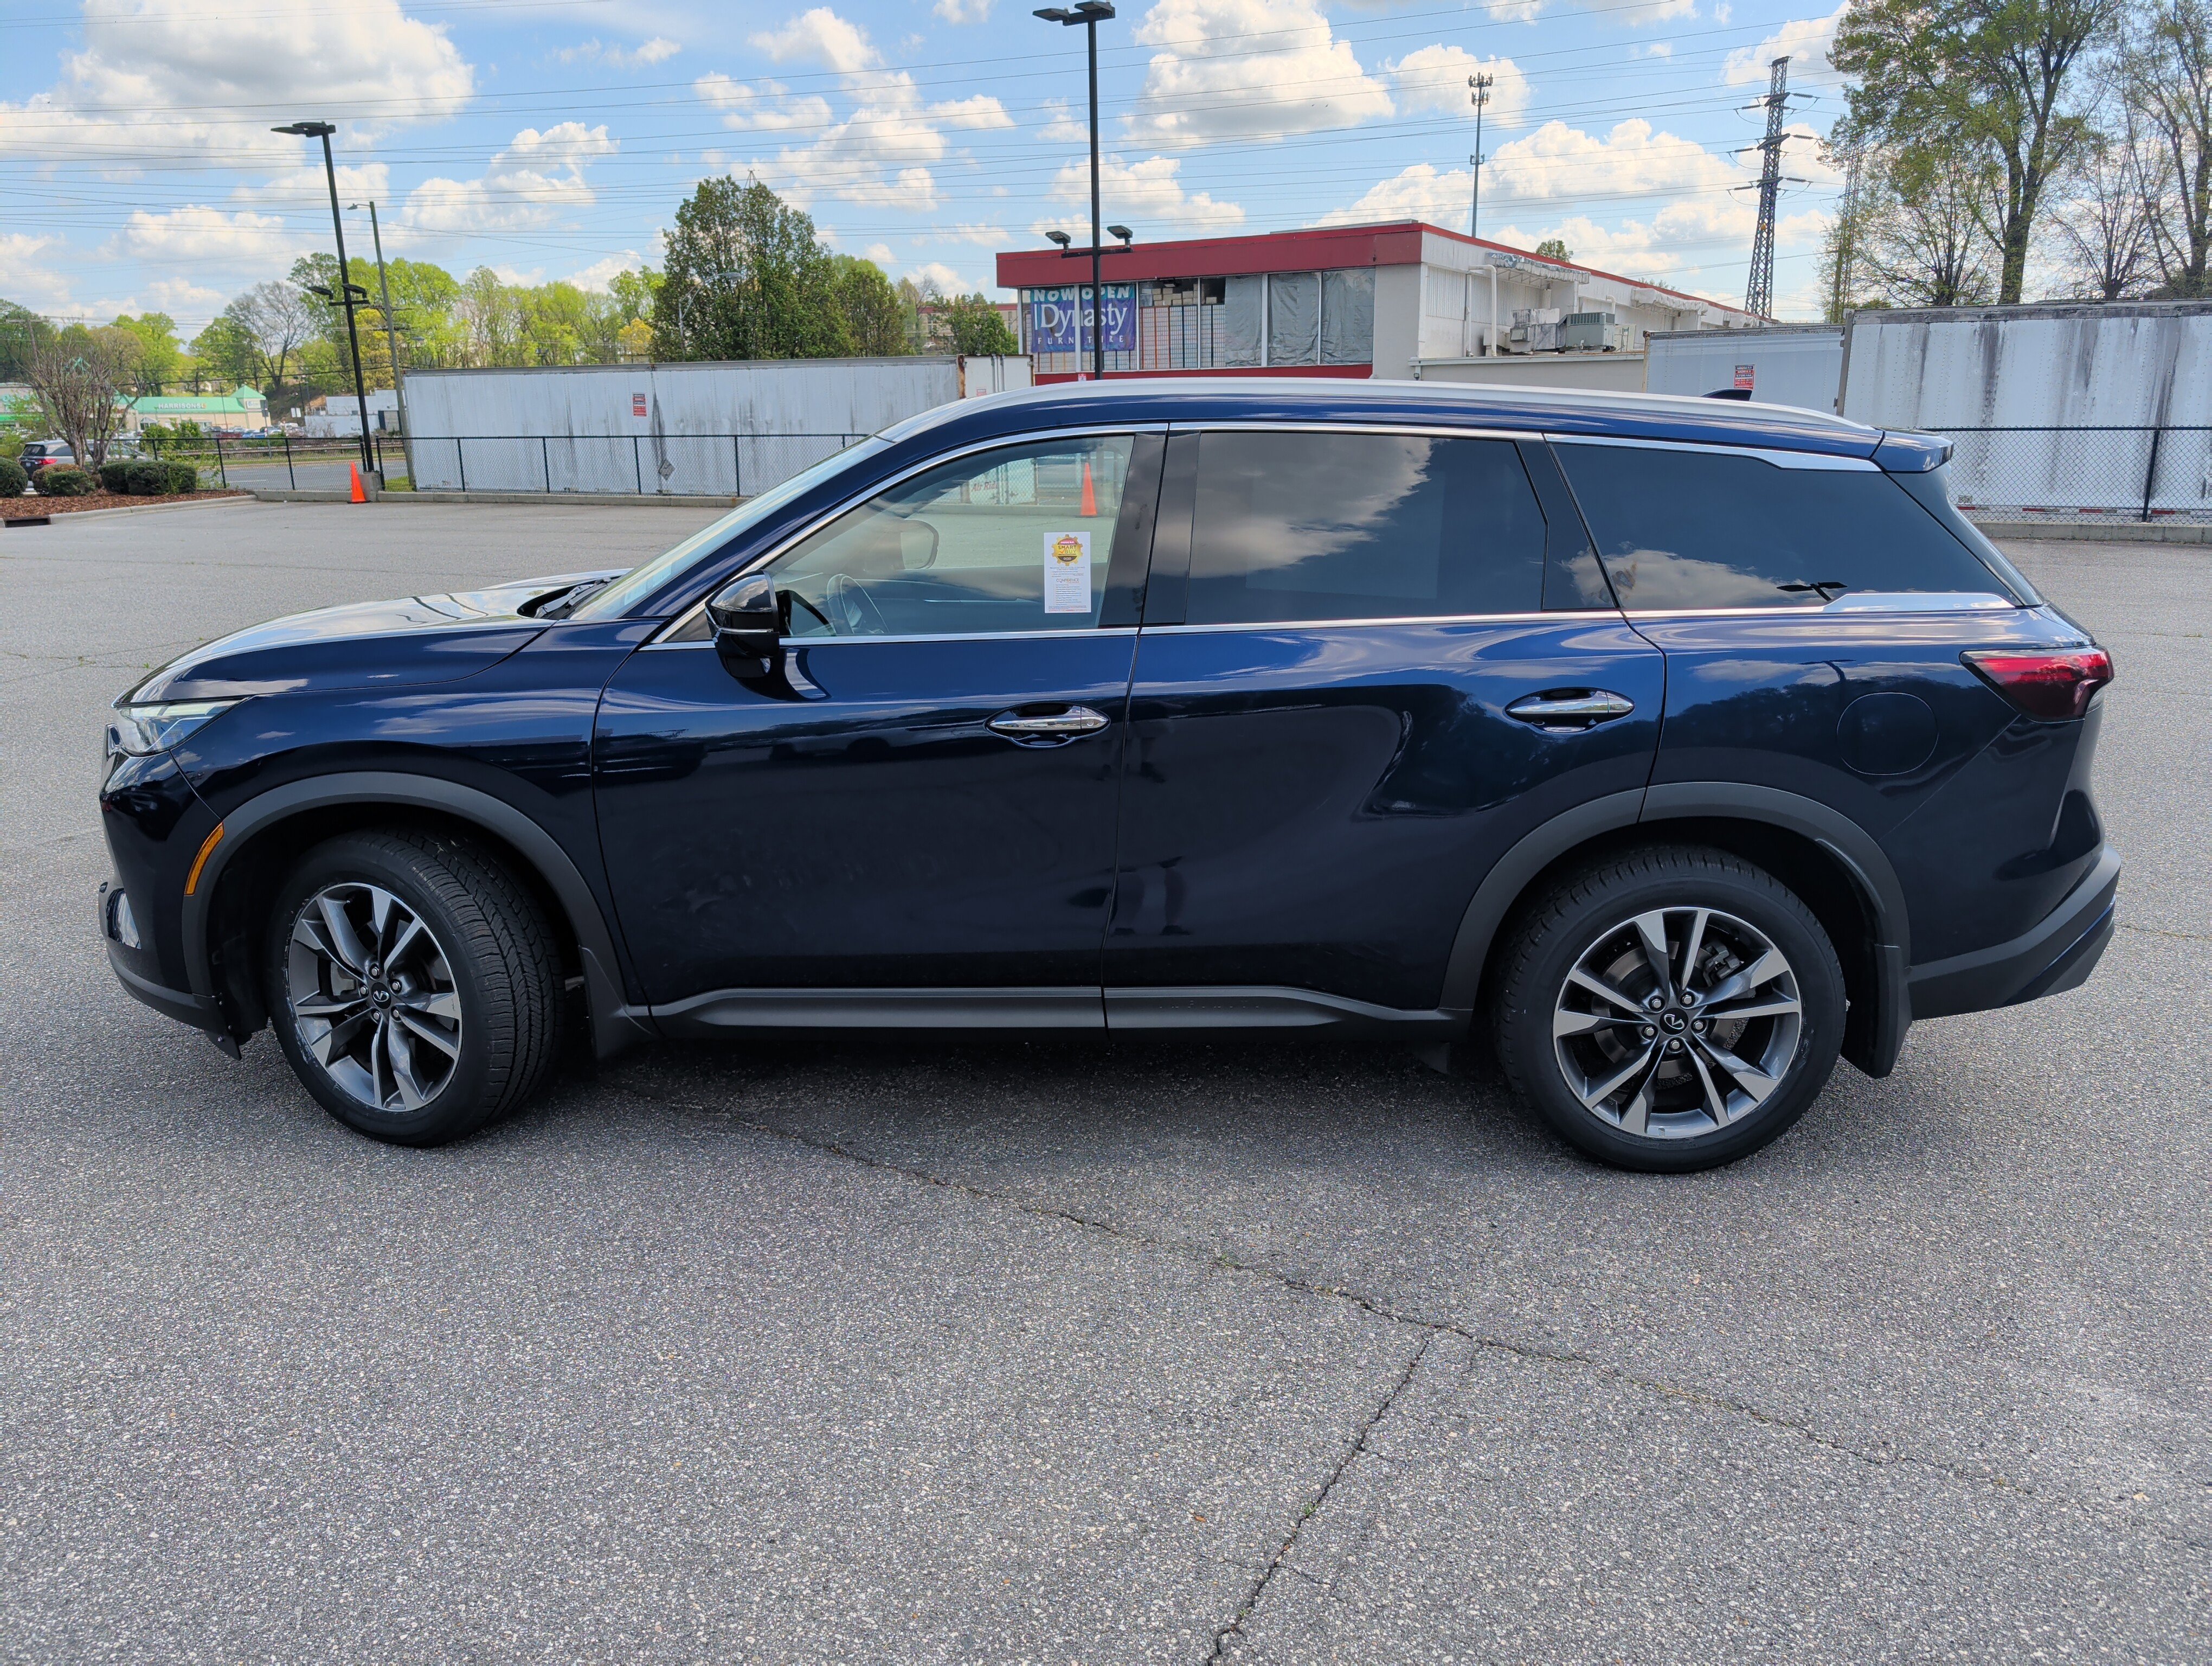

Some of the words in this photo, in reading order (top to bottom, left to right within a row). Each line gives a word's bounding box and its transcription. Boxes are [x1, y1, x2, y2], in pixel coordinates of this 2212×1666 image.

[1034, 289, 1076, 302] NOW
[1040, 303, 1128, 337] Dynasty
[1038, 335, 1124, 344] FURNTRE
